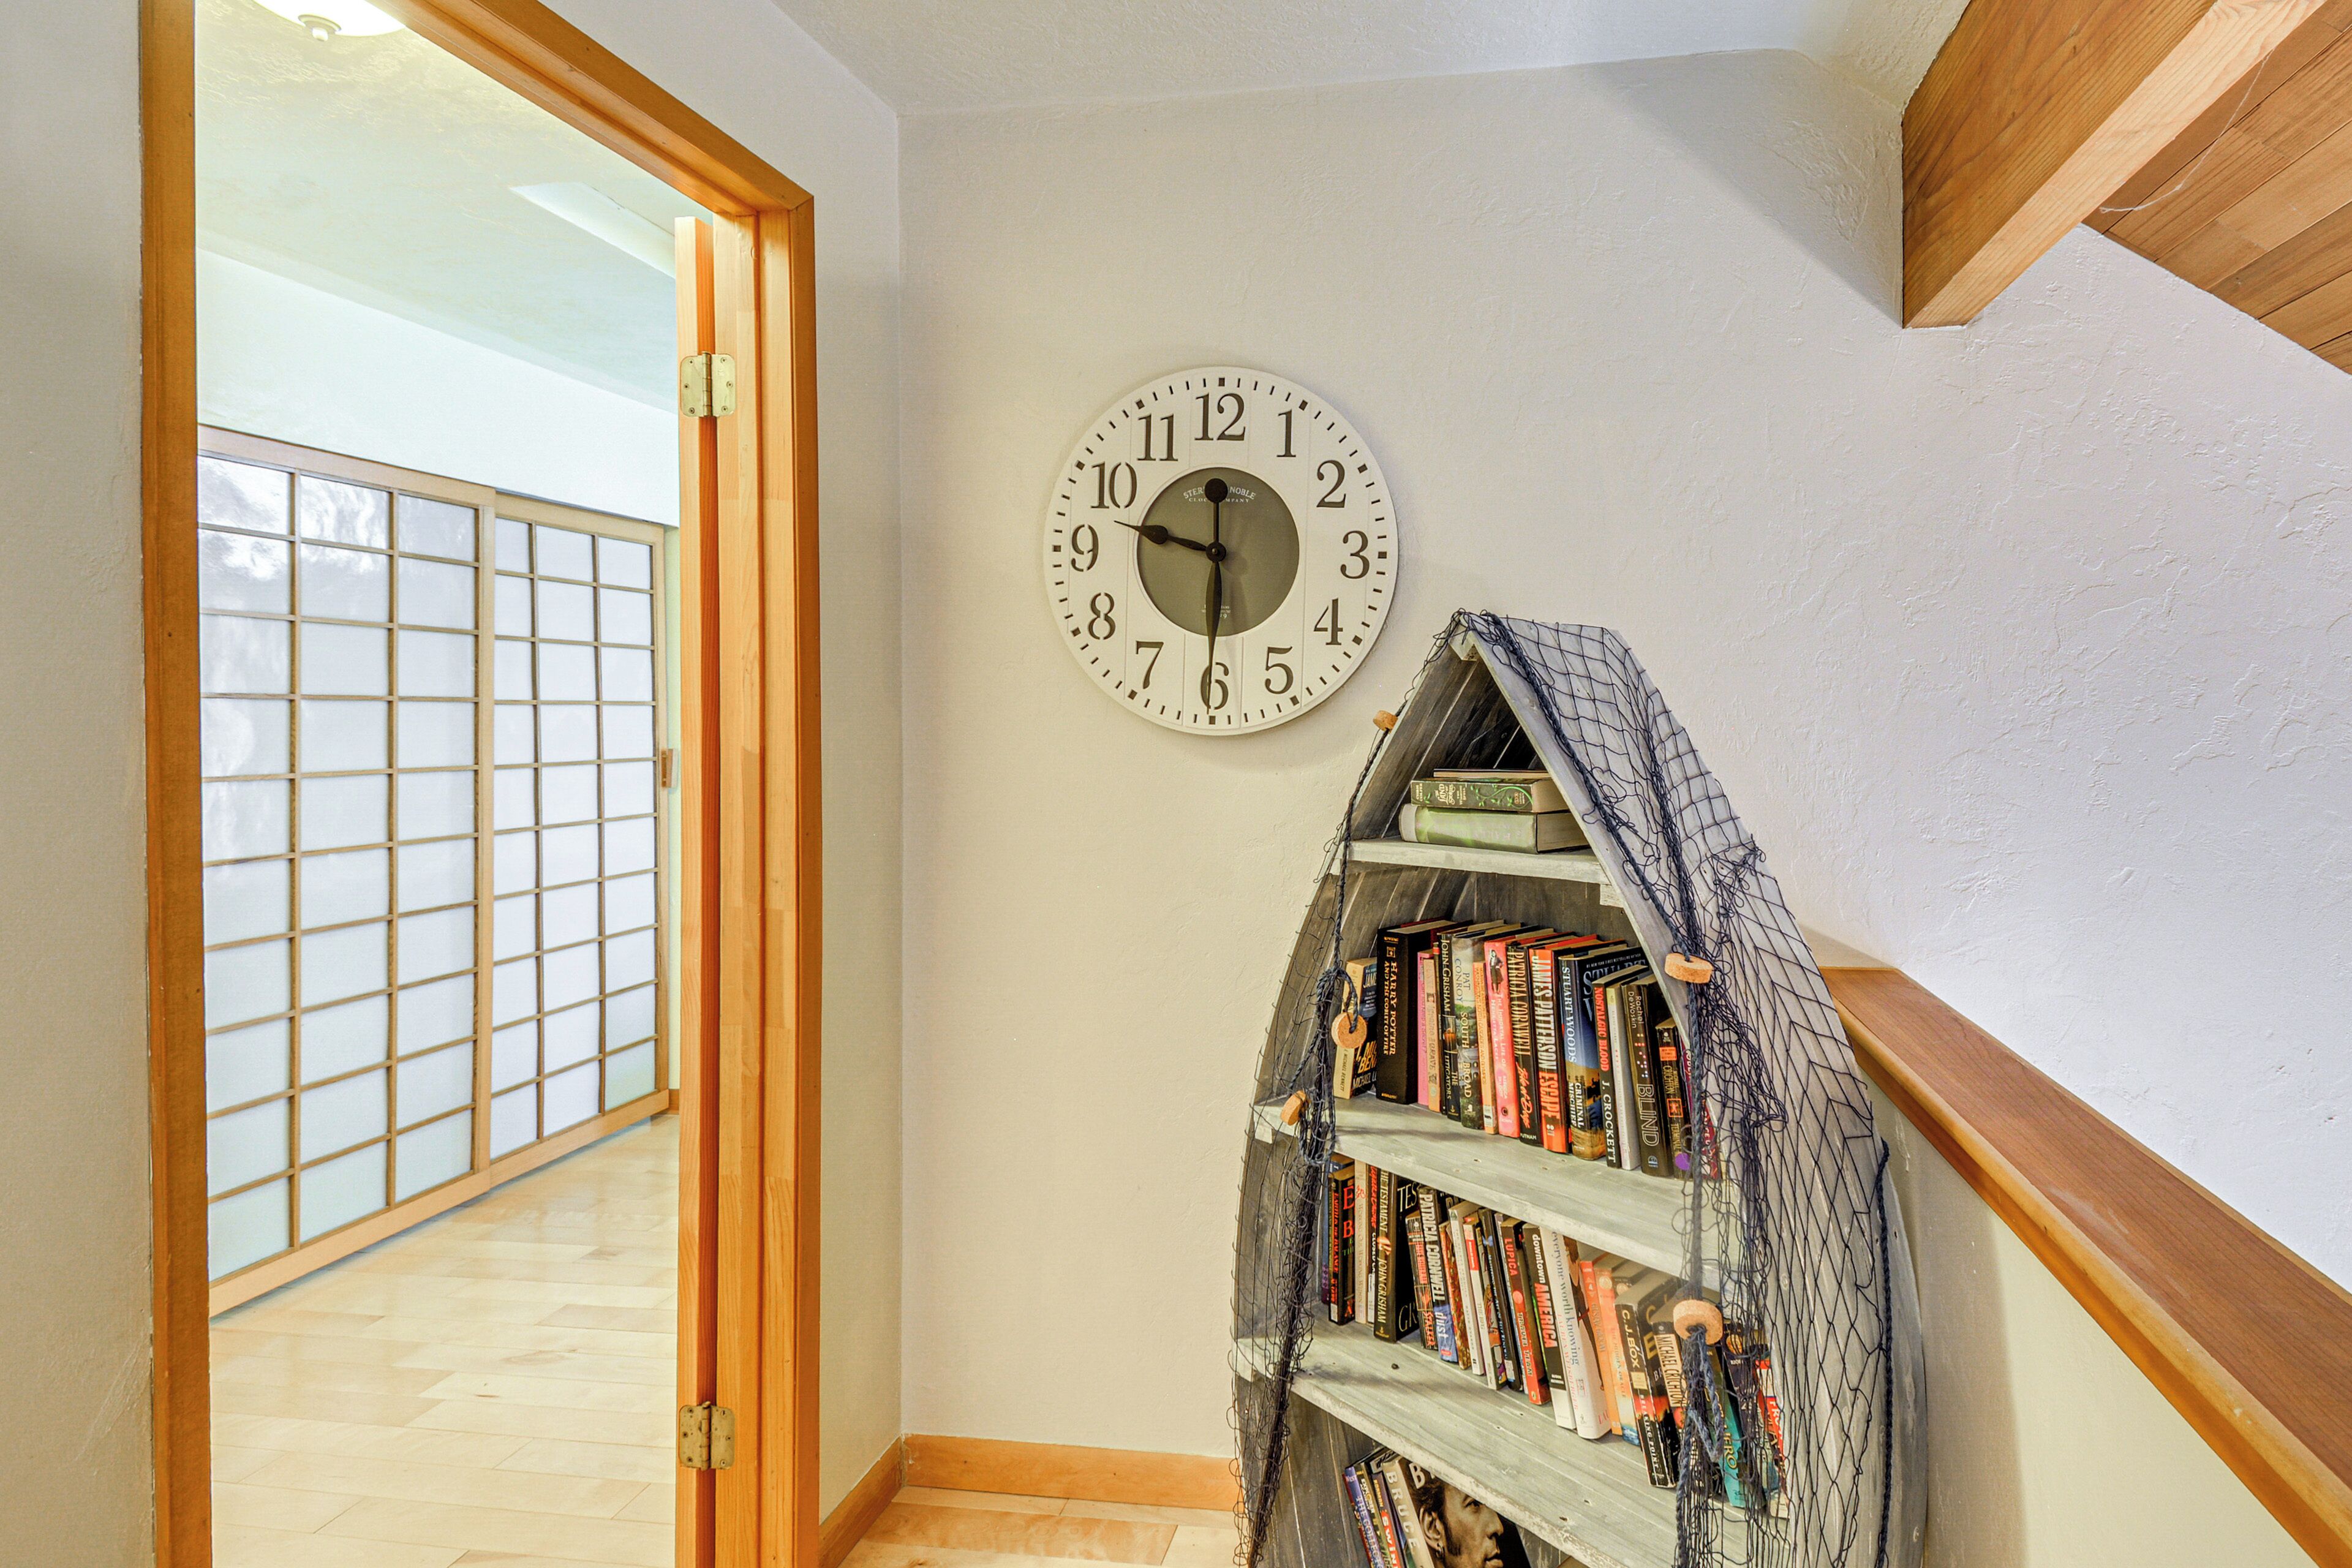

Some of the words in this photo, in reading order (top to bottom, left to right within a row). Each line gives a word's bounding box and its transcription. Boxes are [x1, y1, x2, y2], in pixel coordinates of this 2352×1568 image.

[1137, 413, 1179, 462] 11
[1194, 392, 1246, 442] 12
[1276, 409, 1297, 458] 1
[1090, 461, 1138, 510] 10
[1229, 486, 1256, 500] NOBLE
[1316, 459, 1347, 508] 2
[1071, 524, 1099, 572] 9
[1340, 530, 1370, 579] 3
[1087, 592, 1117, 640] 8
[1313, 597, 1344, 646] 4
[1135, 640, 1164, 690] 7
[1200, 662, 1230, 710] 6
[1264, 646, 1294, 695] 5
[1441, 940, 1450, 965] JOHN
[1507, 952, 1527, 997] PATRICIA
[1389, 960, 1398, 1009] HARRY
[1442, 968, 1452, 1012] GRISHAM
[1455, 958, 1463, 1003] CONROY
[1531, 956, 1553, 997] JAMES
[1561, 967, 1574, 1014] STUART
[1383, 1025, 1389, 1035] OF
[1389, 1009, 1397, 1055] POTTER
[1460, 1012, 1470, 1049] SOUTH
[1510, 1001, 1531, 1057] CORNWELL
[1594, 987, 1608, 1038] NOSTALGIC
[1628, 991, 1637, 1028] DeWoskin
[1635, 995, 1645, 1024] Rachel
[1534, 1000, 1557, 1070] PATTERSON
[1566, 1016, 1577, 1063] WOODS
[1598, 1039, 1610, 1072] BLOOD
[1352, 1072, 1371, 1090] MICHAEL
[1463, 1061, 1472, 1098] BROAD
[1515, 1062, 1529, 1087] Isle
[1520, 1087, 1530, 1100] of
[1539, 1071, 1560, 1120] ESCAPE
[1602, 1080, 1610, 1090] J.
[1663, 1065, 1674, 1094] CRICHTON
[1520, 1098, 1532, 1129] Dogs
[1568, 1082, 1577, 1127] MISCHIEF
[1575, 1082, 1585, 1128] CRIMINAL
[1637, 1084, 1660, 1147] BLIND
[1603, 1093, 1616, 1163] CROCKETT
[1670, 1123, 1681, 1151] TERMINAL
[1379, 1186, 1389, 1233] TESTAMENT
[1419, 1194, 1438, 1242] PATRICIA
[1377, 1257, 1387, 1283] JOHN
[1425, 1244, 1446, 1302] CORNWELL
[1504, 1238, 1518, 1276] LUPICA
[1532, 1234, 1546, 1284] downtown
[1551, 1231, 1564, 1281] everyone
[1377, 1283, 1387, 1324] GRISHAM
[1534, 1282, 1558, 1348] AMERICA
[1560, 1283, 1574, 1314] worth
[1422, 1311, 1436, 1347] STALKER
[1434, 1312, 1449, 1339] dust
[1517, 1312, 1529, 1347] TRAVEL
[1524, 1350, 1533, 1377] TEAM
[1566, 1316, 1580, 1366] knowing
[1558, 1314, 1567, 1350] LAUREN
[1564, 1351, 1578, 1410] WEISBERGER
[1627, 1338, 1641, 1368] BOX
[1656, 1335, 1677, 1367] MICHAEL
[1665, 1368, 1683, 1408] CRICHTON
[1639, 1394, 1652, 1438] BREAKING
[1648, 1441, 1659, 1468] POINT
[1355, 1496, 1368, 1517] THE
[1361, 1478, 1374, 1513] EXPLORER
[1373, 1480, 1384, 1507] KORMAN
[1385, 1471, 1417, 1550] BRUCE
[1382, 1516, 1398, 1568] SWIN
